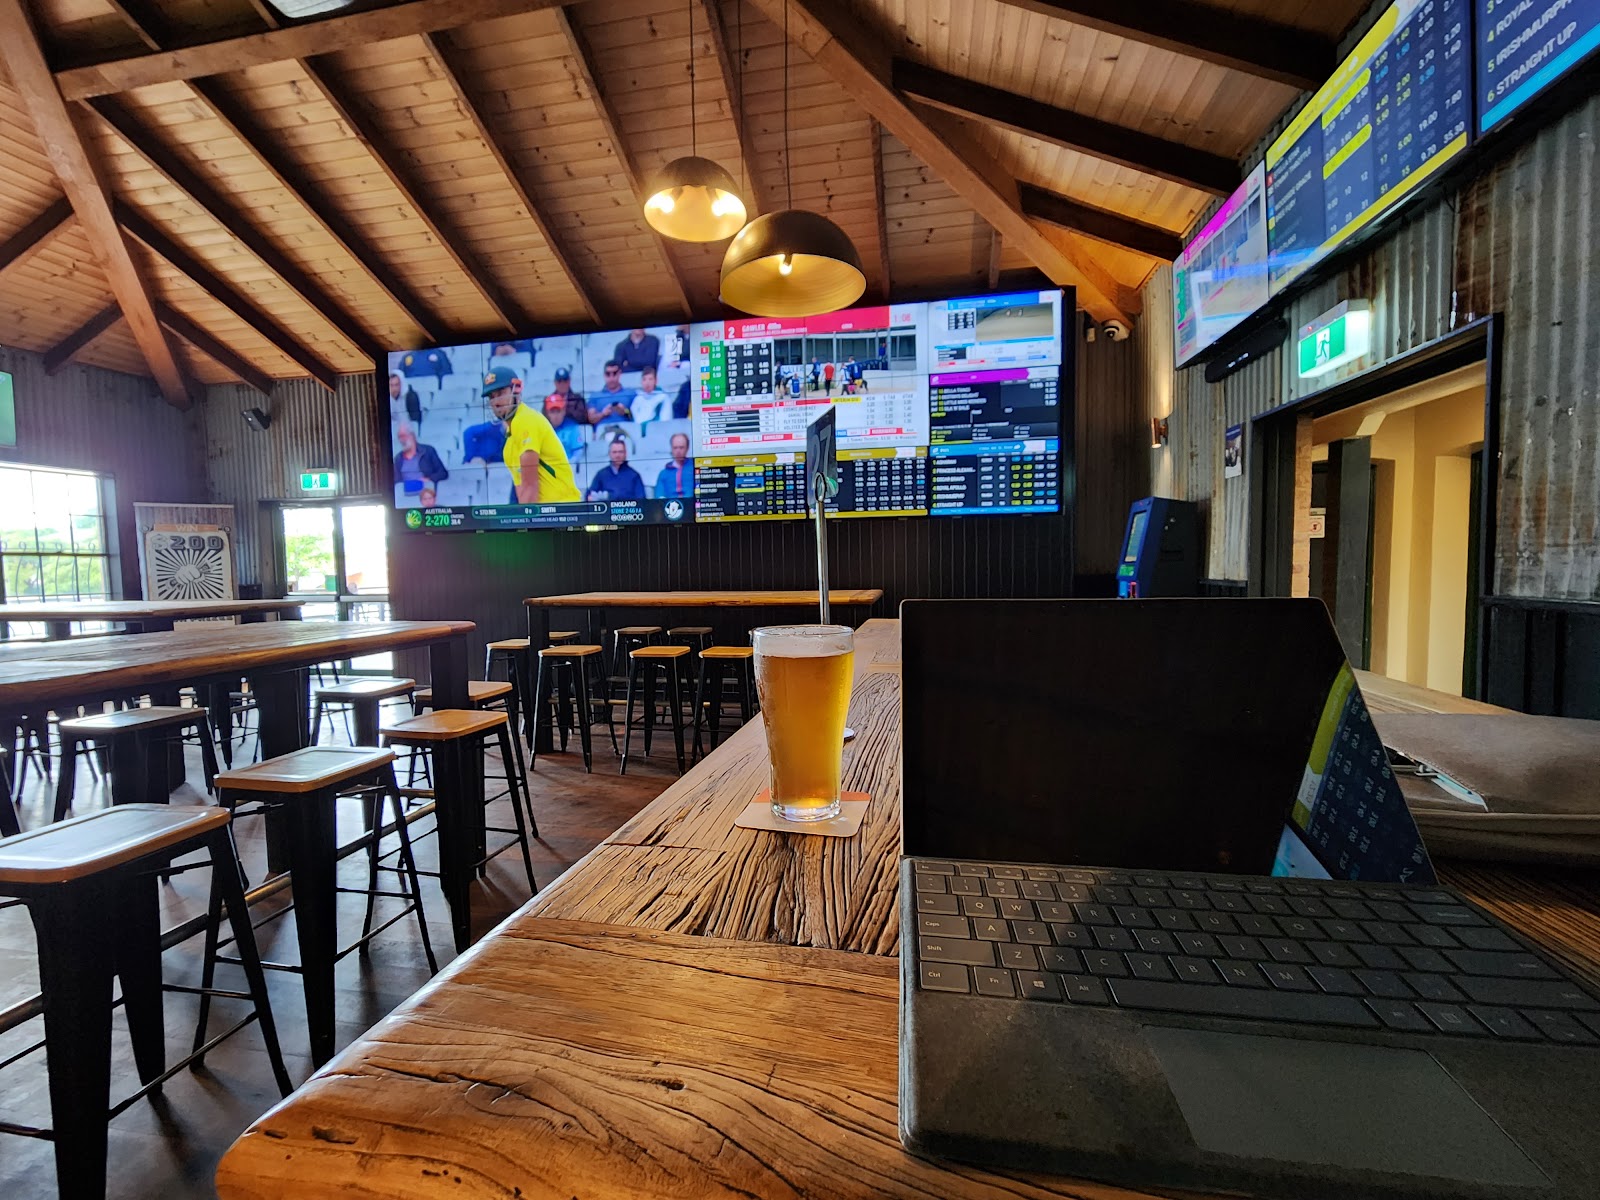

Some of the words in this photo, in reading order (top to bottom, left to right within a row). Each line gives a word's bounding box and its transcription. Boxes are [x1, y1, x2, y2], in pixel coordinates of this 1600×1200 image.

[1487, 30, 1494, 42] 4
[1487, 90, 1495, 102] 6
[1496, 38, 1556, 95] STRAIGHT
[1556, 22, 1577, 45] UP
[1488, 59, 1494, 73] 5
[728, 326, 735, 339] 2
[426, 515, 449, 526] 2-270
[151, 534, 224, 551] $200
[975, 902, 984, 910] Q
[1192, 939, 1203, 947] H
[1100, 958, 1109, 966] C
[1142, 960, 1152, 969] V
[1188, 965, 1198, 973] B
[1232, 968, 1247, 977] N
[1279, 972, 1294, 980] M
